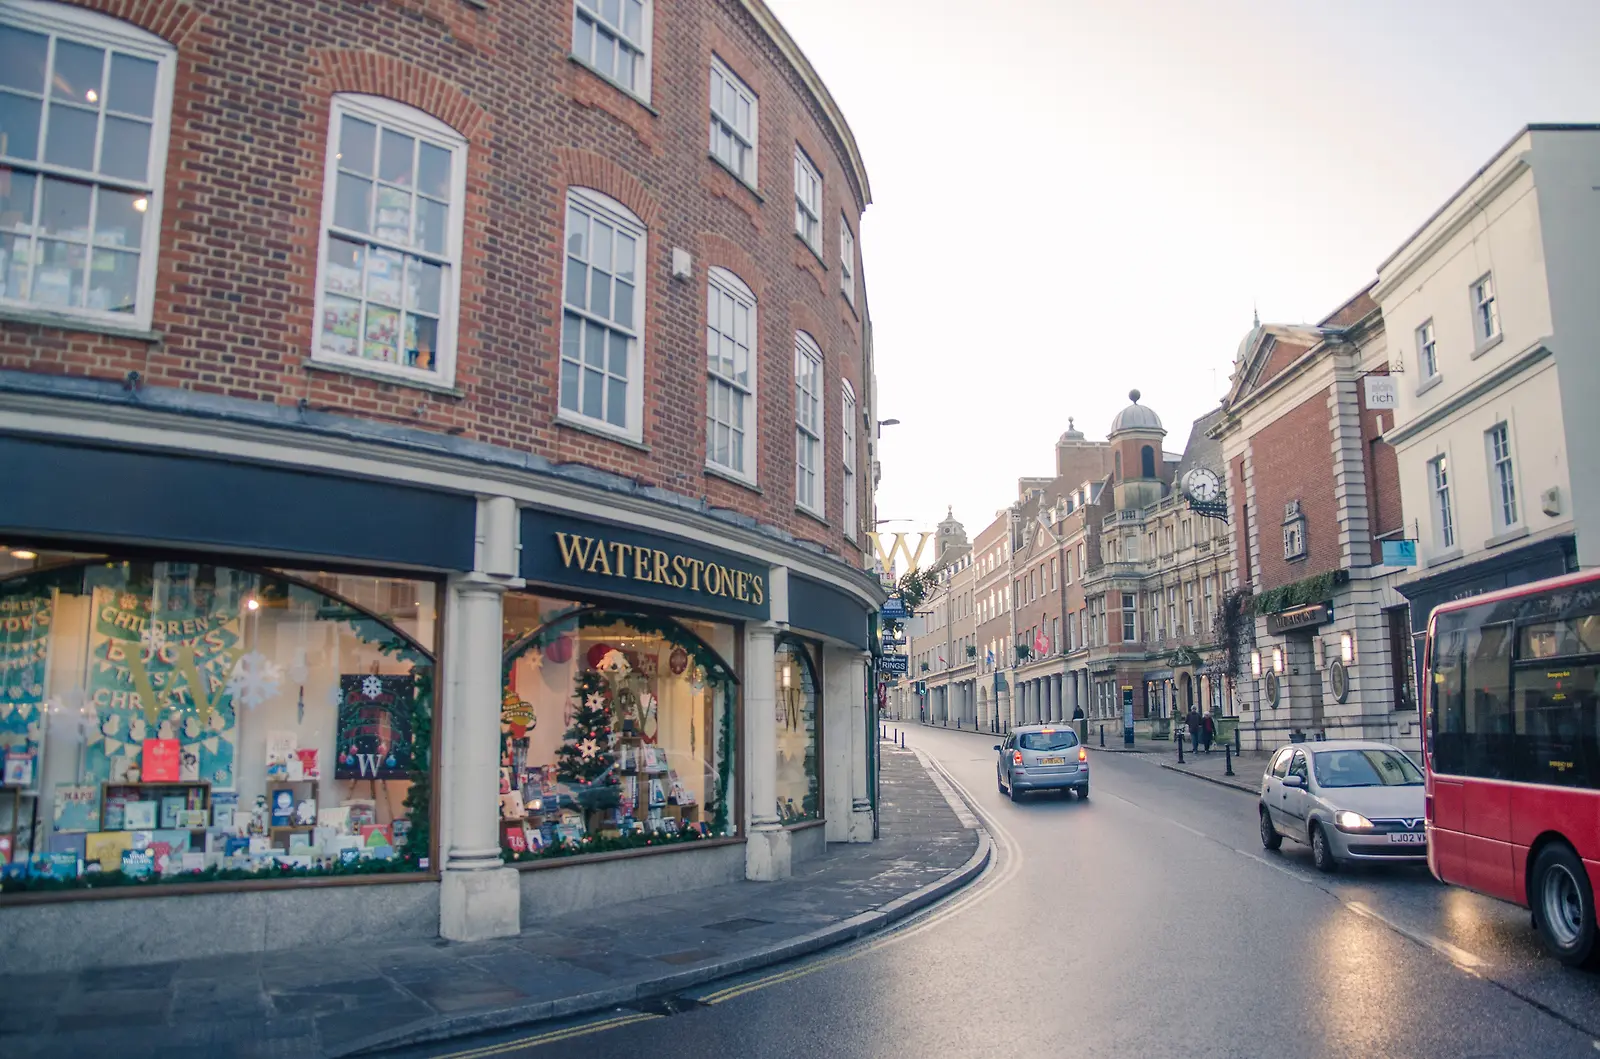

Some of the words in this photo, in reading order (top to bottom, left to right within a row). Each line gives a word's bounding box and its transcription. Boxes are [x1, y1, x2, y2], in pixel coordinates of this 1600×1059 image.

[1372, 392, 1394, 403] rich
[866, 532, 934, 574] W
[555, 531, 763, 605] WATERSTONE'S
[101, 606, 229, 636] CHILDREN'S
[882, 661, 906, 670] RINGS
[356, 753, 383, 778] W
[1390, 833, 1415, 843] LJ02
